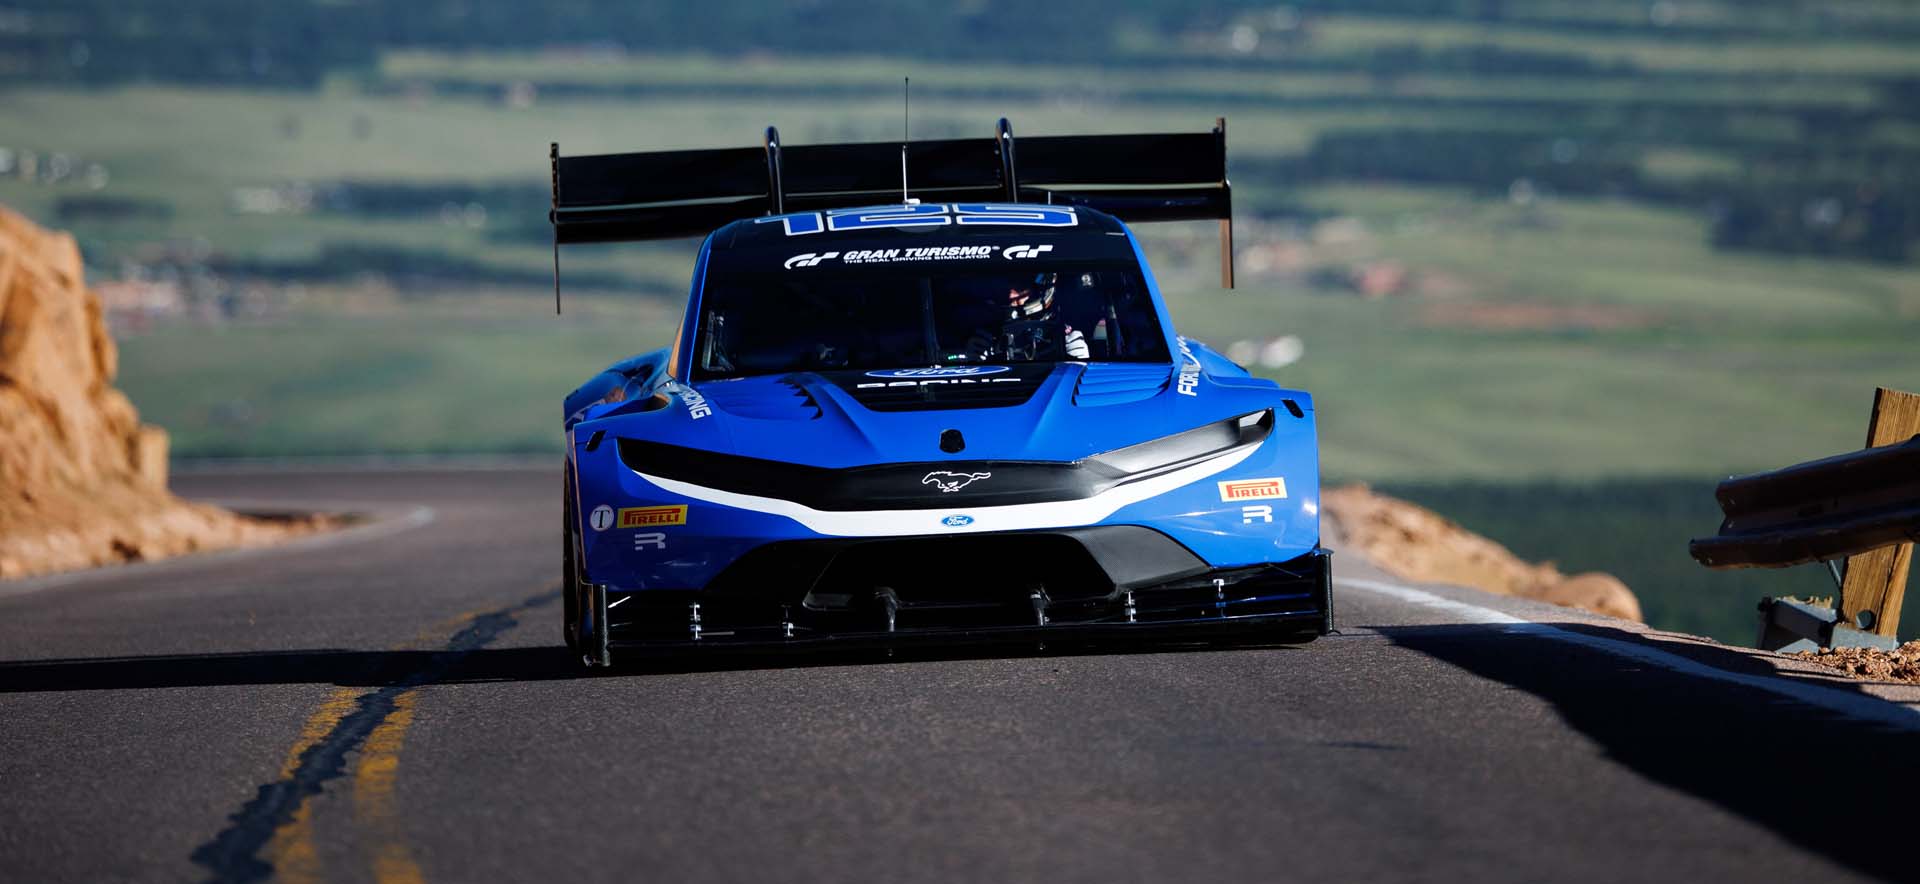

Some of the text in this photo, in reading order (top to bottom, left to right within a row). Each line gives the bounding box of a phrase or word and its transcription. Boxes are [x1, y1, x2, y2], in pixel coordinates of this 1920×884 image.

[754, 203, 1077, 235] 125
[843, 249, 901, 260] GRAN
[1226, 481, 1280, 499] PIRELLI
[594, 509, 611, 529] T
[623, 508, 682, 526] PIRELLI
